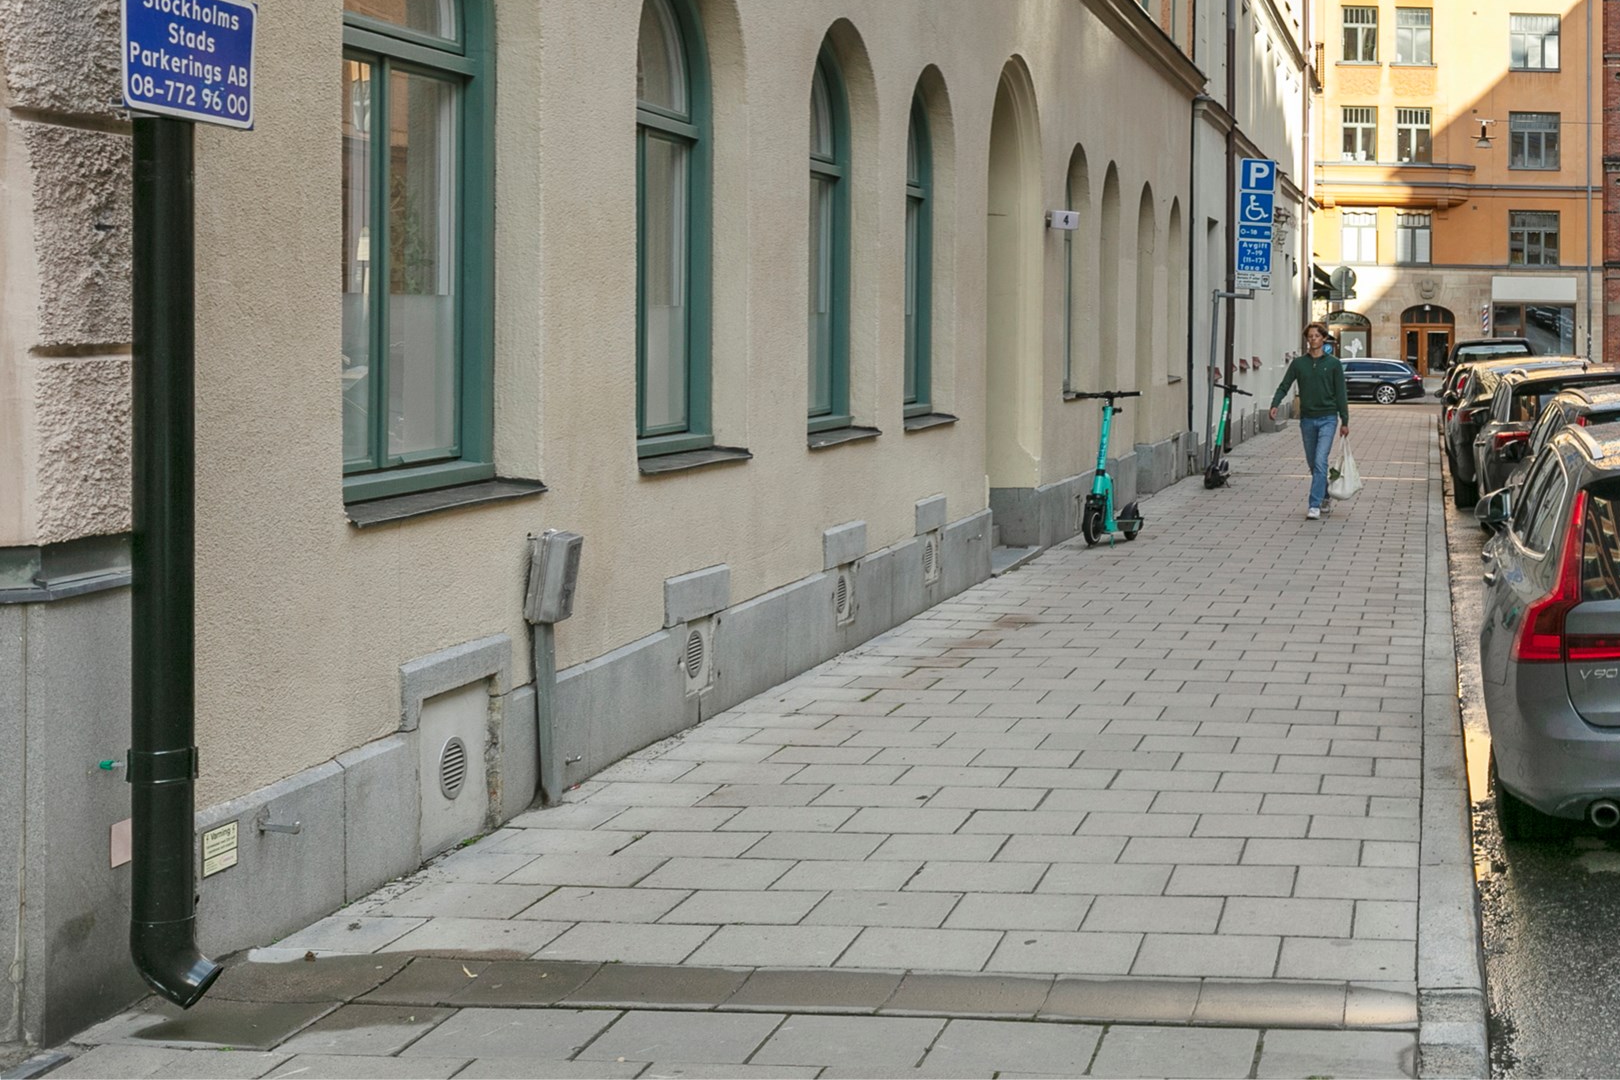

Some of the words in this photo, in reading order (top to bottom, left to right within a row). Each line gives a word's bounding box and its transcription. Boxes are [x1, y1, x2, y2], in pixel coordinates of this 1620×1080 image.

[168, 22, 216, 53] Stads
[130, 41, 222, 84] Parkerings
[227, 64, 248, 88] AB
[131, 73, 197, 107] 08-772
[202, 88, 222, 111] 96
[227, 93, 248, 116] 00
[1249, 162, 1269, 188] P
[1063, 214, 1070, 226] 4
[1242, 242, 1268, 250] Avgift
[1240, 263, 1260, 271] Taxa
[1580, 668, 1618, 680] V90
